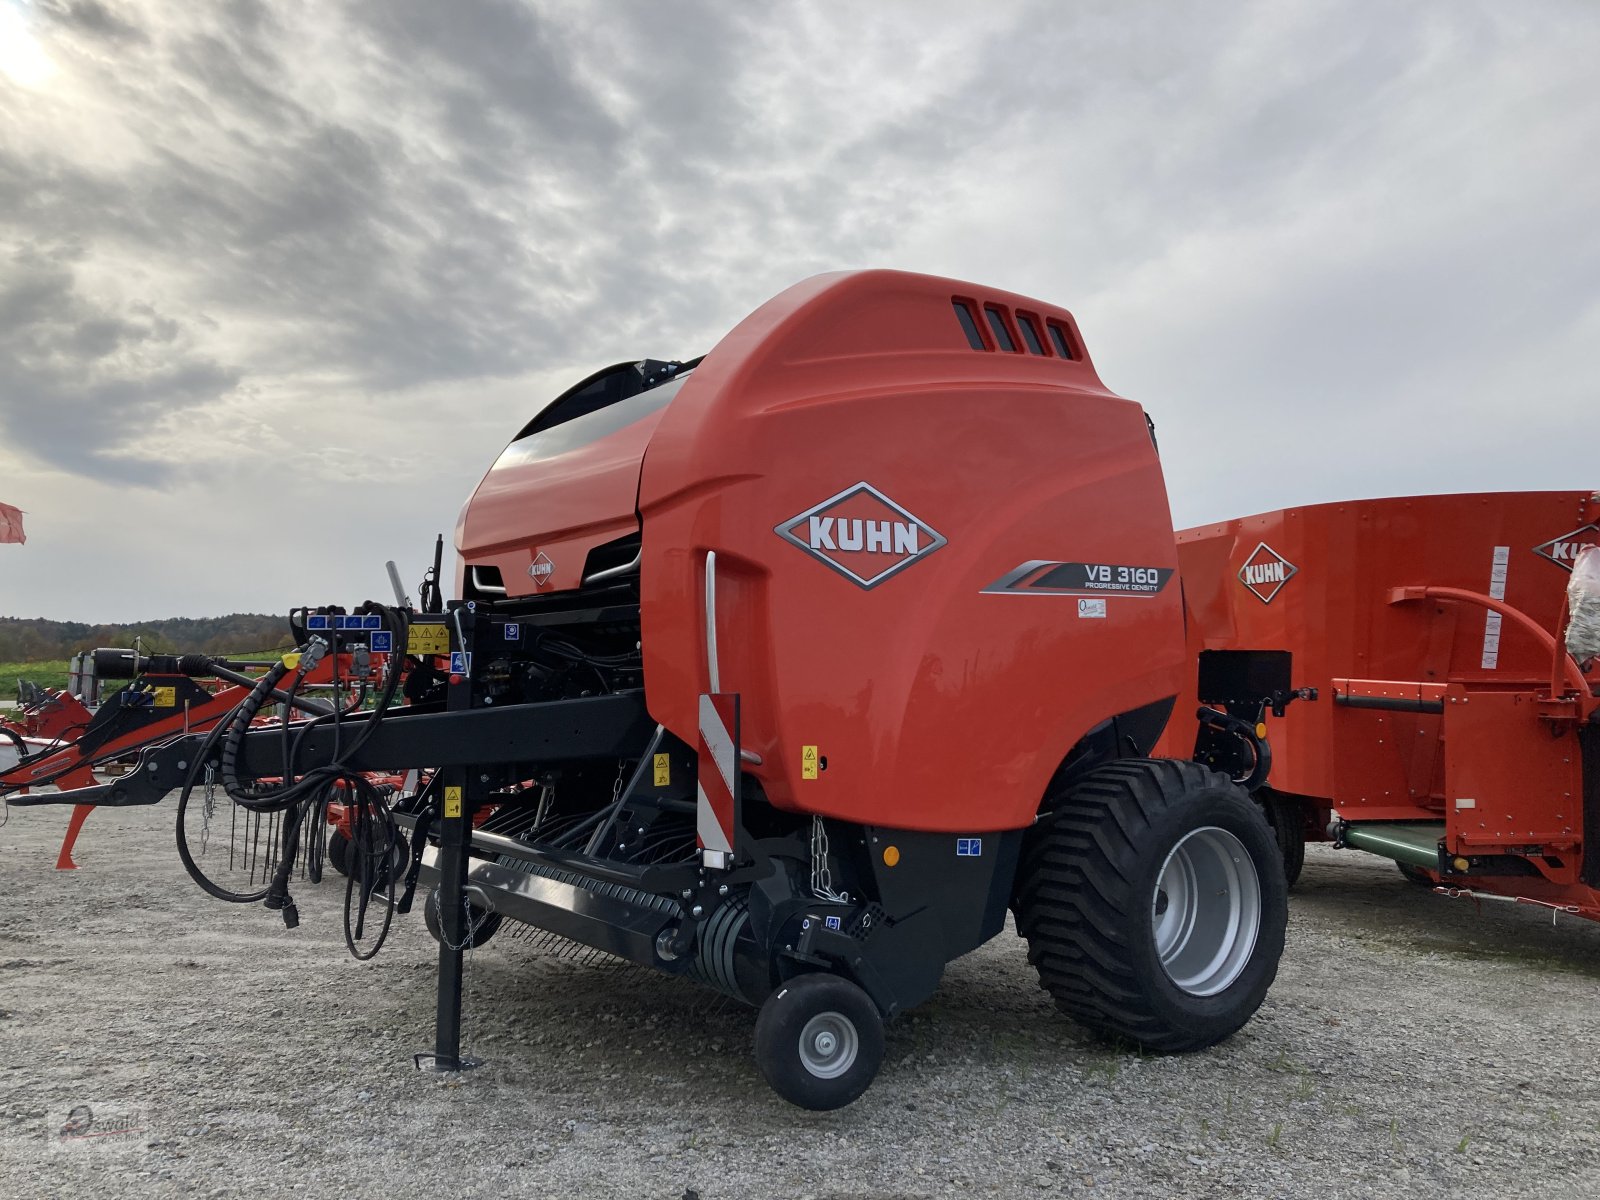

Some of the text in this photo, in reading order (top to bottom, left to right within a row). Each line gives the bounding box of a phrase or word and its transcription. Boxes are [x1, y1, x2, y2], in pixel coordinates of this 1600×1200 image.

[809, 516, 919, 555] KUHN
[1552, 542, 1588, 560] KU
[531, 563, 552, 576] KUHN
[1084, 564, 1159, 585] VB 3160
[1245, 561, 1285, 585] KUHN
[1085, 581, 1159, 592] PROGRESSIVE DENSITY
